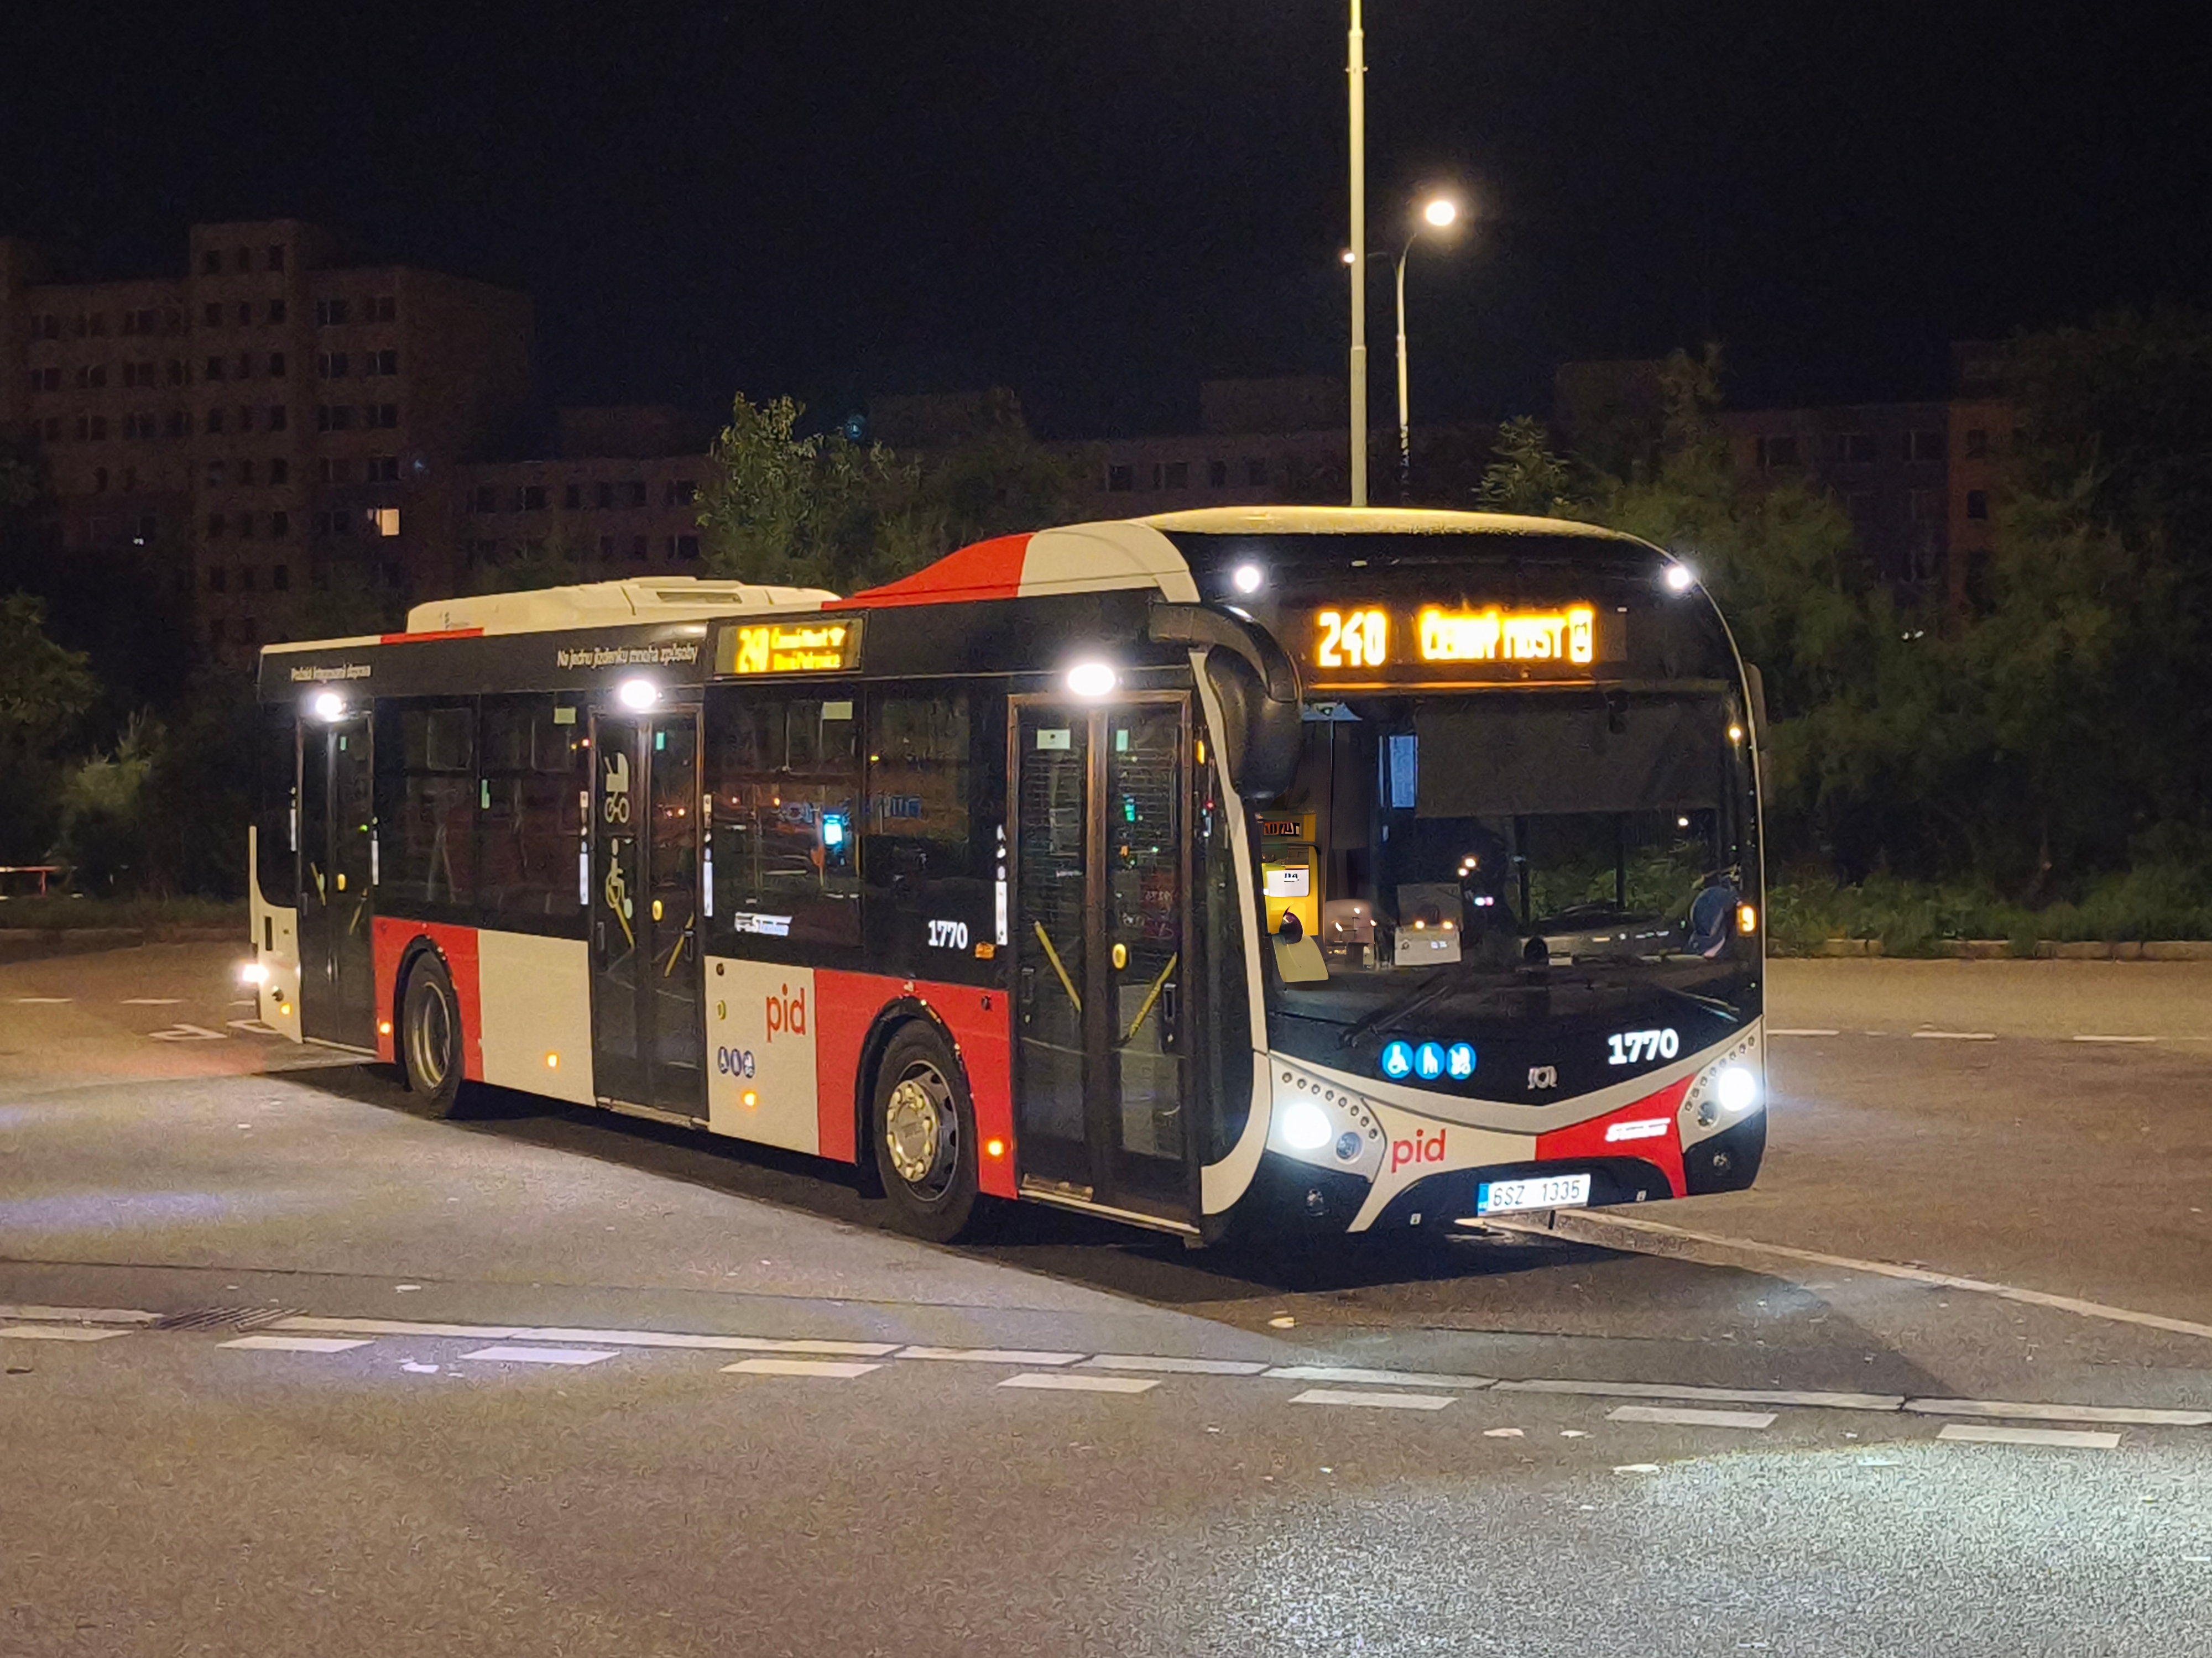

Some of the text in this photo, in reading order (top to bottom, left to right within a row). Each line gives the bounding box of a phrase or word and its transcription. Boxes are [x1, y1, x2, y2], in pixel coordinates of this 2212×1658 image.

[1319, 611, 1386, 667] 240
[928, 919, 968, 950] 1770
[766, 982, 806, 1044] pid
[1608, 1028, 1679, 1065] 1770
[1391, 1128, 1446, 1174] pid
[1493, 1179, 1580, 1206] 6SZ 1335
